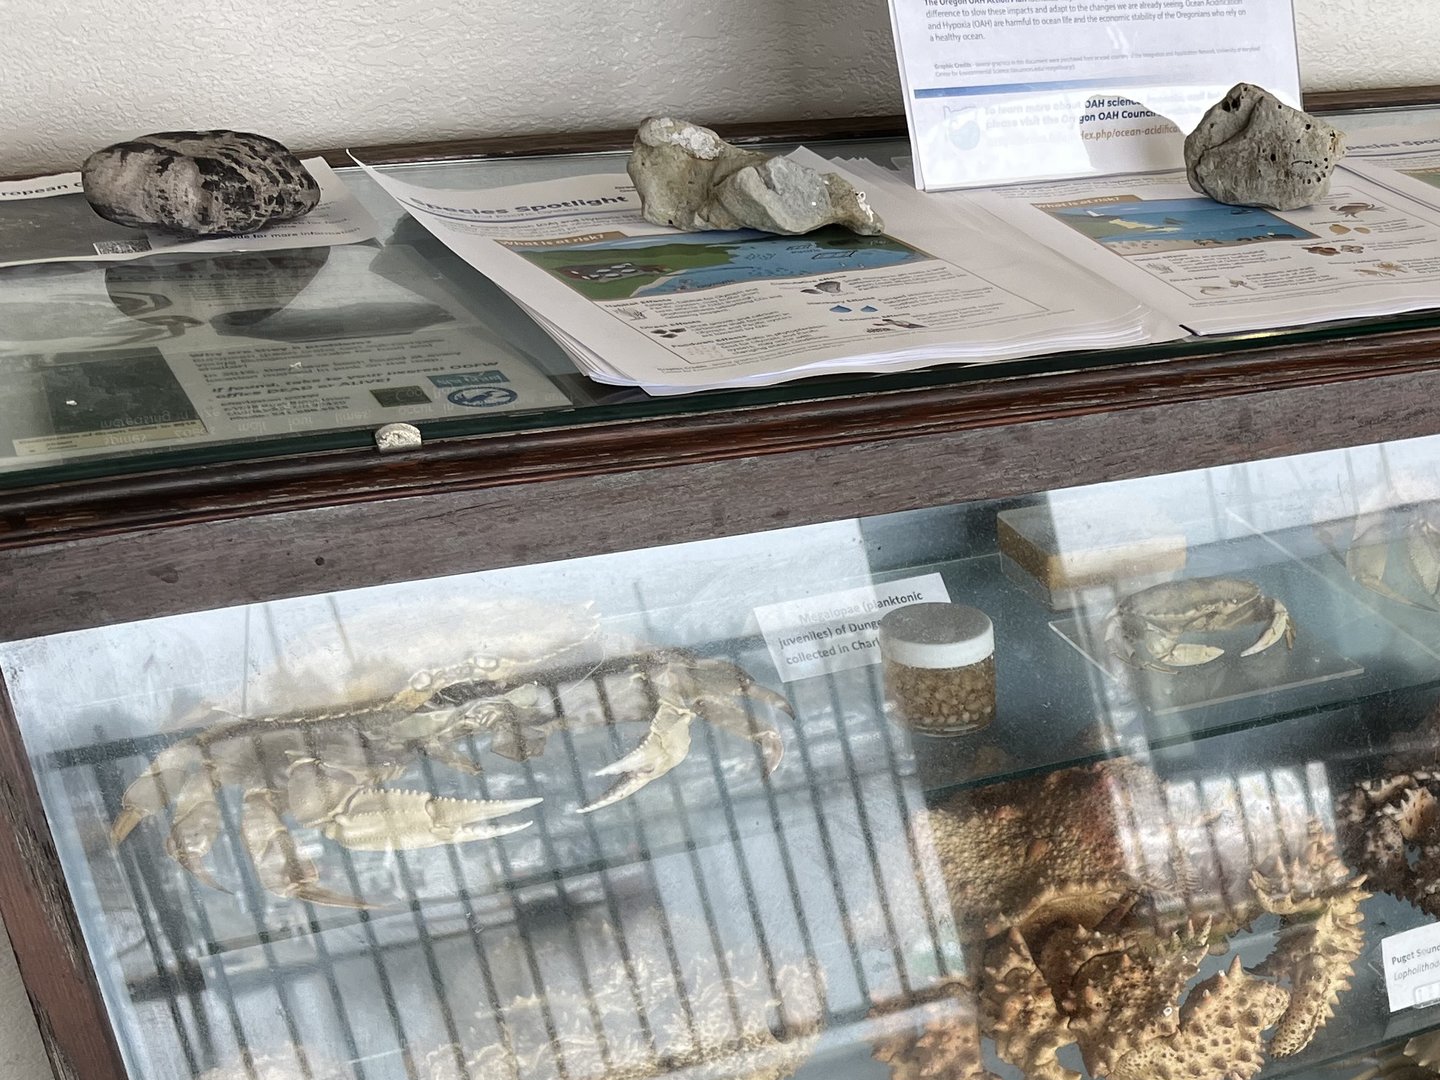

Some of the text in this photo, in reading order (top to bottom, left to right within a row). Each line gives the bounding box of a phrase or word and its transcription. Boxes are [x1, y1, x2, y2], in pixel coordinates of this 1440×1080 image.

[926, 9, 961, 19] difference
[971, 8, 987, 16] slow
[988, 7, 1006, 15] these
[1007, 6, 1034, 15] impacts
[1035, 5, 1048, 14] and
[1049, 4, 1068, 13] adapt
[1077, 3, 1088, 11] the
[1089, 3, 1116, 12] changes
[1139, 1, 1161, 10] already
[928, 21, 941, 30] and
[942, 20, 971, 31] Hypoxia
[972, 18, 992, 28] (OAH)
[1005, 17, 1031, 26] harmful
[1062, 15, 1072, 24] life
[1073, 15, 1086, 23] and
[1087, 14, 1098, 22] the
[1099, 14, 1130, 22] economic
[1131, 11, 1156, 21] stability
[1157, 11, 1163, 19] of
[1164, 11, 1175, 19] the
[1176, 10, 1211, 19] Oregonians
[1212, 8, 1225, 17] who
[1226, 8, 1237, 17] rely
[935, 32, 961, 42] healthy
[962, 32, 986, 41] ocean.
[1098, 111, 1119, 121] OAH
[514, 194, 630, 213] Spotlight
[499, 239, 537, 249] What
[571, 233, 605, 245] risk?
[798, 590, 924, 626] Megalopae (planktonic
[777, 619, 883, 650] juveniles) of Dunge
[785, 637, 880, 666] collected in Charl
[1391, 950, 1416, 966] Puget
